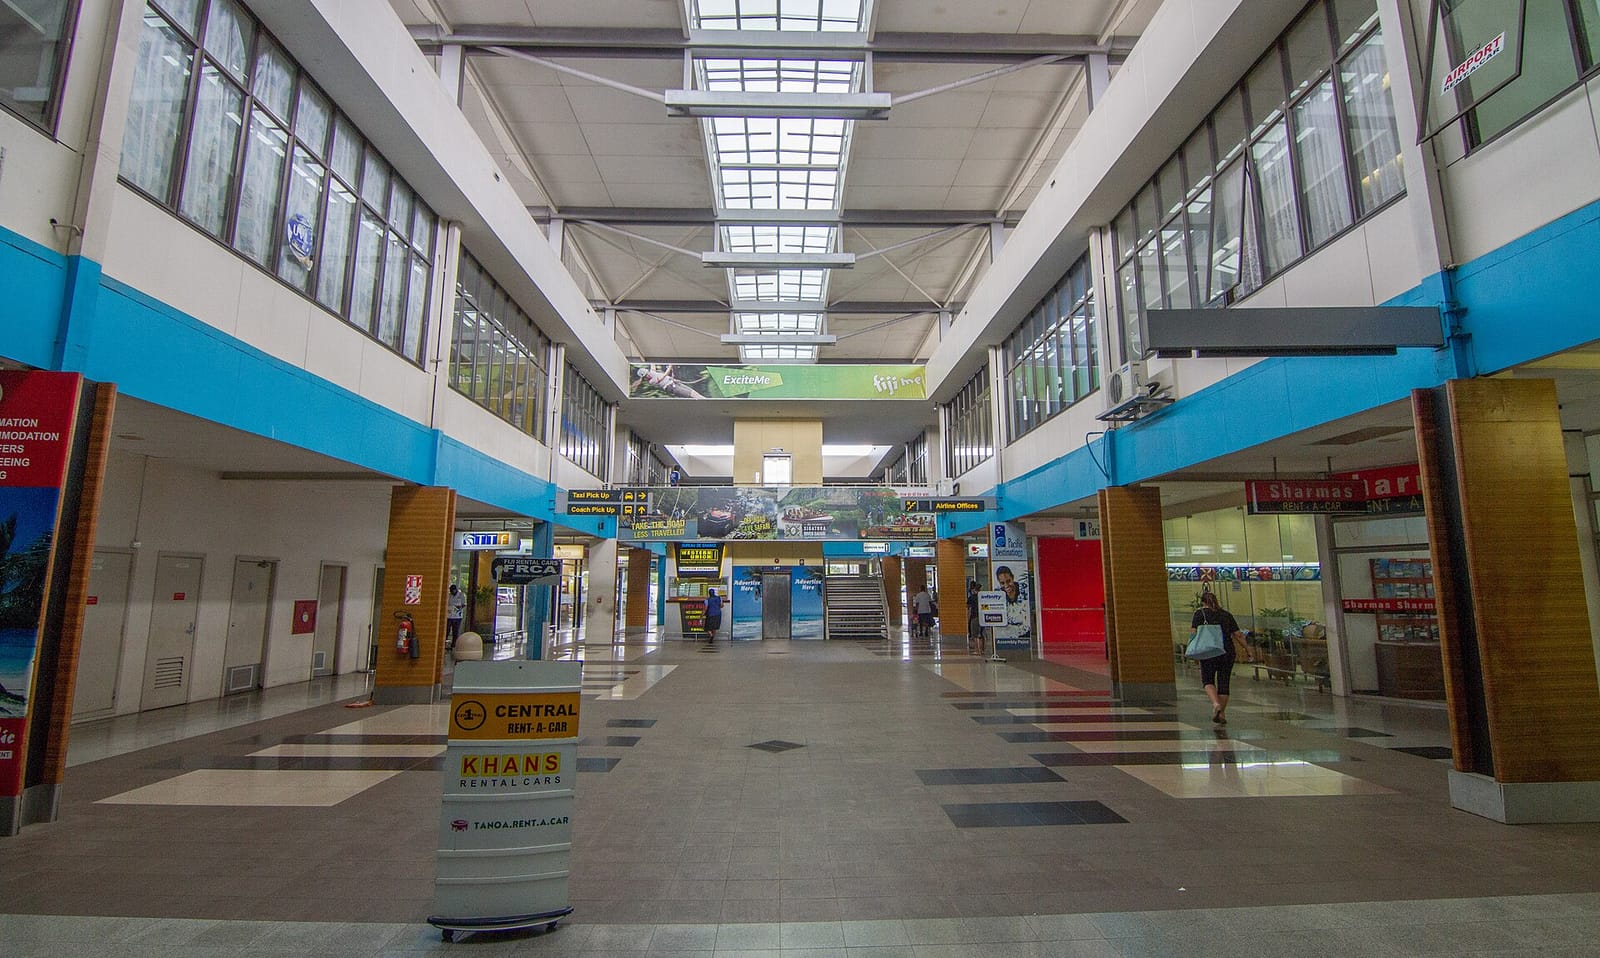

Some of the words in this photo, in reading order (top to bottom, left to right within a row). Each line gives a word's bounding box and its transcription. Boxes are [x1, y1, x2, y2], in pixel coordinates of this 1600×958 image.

[1445, 35, 1502, 86] AIRPORT
[723, 375, 771, 385] ExciteMe
[873, 374, 898, 396] fiji
[900, 376, 922, 386] me
[0, 431, 60, 441] MODATION
[1269, 481, 1353, 499] Sharmas
[600, 492, 610, 500] Up
[631, 522, 648, 530] TAKE
[651, 521, 666, 529] THE
[667, 519, 685, 529] ROAD
[651, 528, 685, 537] TRAVELLED
[1008, 538, 1023, 548] Pacific
[503, 565, 557, 574] FRCA
[1344, 600, 1391, 609] Sharmas
[496, 704, 577, 718] CENTRAL
[463, 755, 559, 774] KHANS
[459, 779, 517, 788] RENTAL
[523, 776, 561, 786] CARS
[474, 816, 569, 830] TANOA.RENT.A.CAR
